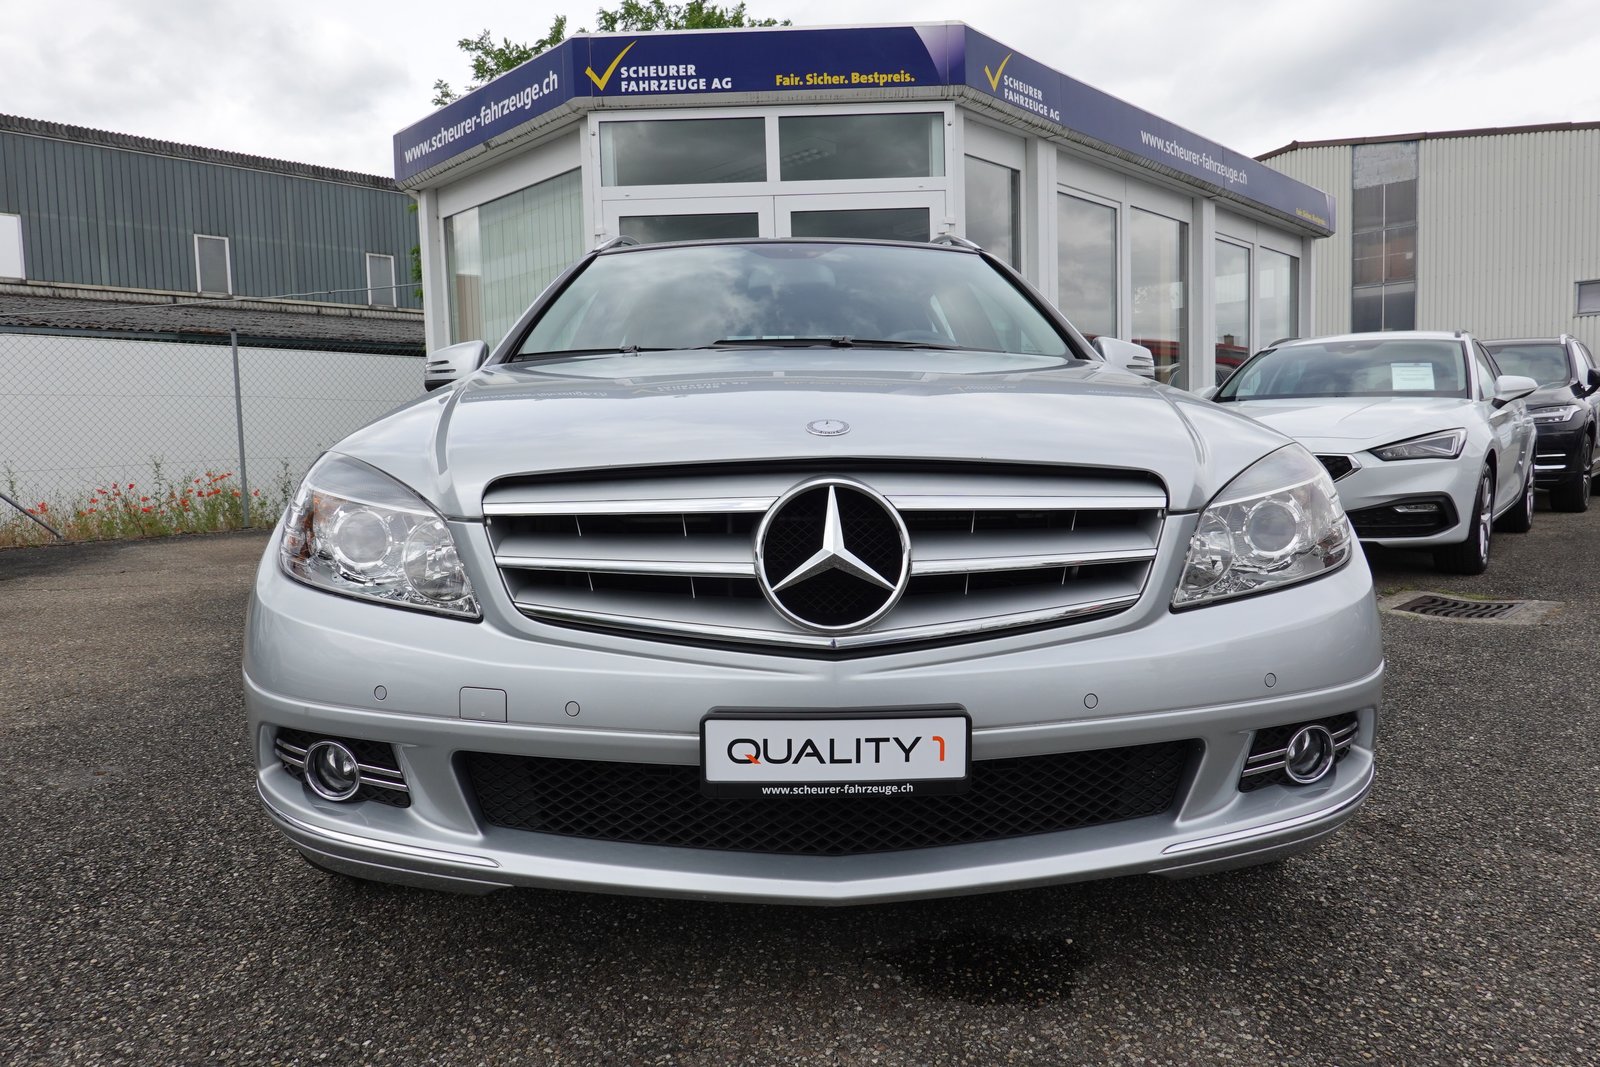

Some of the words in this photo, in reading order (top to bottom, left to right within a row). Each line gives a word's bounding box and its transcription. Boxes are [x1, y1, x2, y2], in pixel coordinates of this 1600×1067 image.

[620, 64, 697, 78] SCHEURER
[775, 73, 803, 86] Fair.
[805, 72, 849, 85] Sicher.
[851, 70, 916, 86] Bestpreis.
[621, 78, 707, 92] FAHRZEUGE
[711, 77, 732, 89] AG
[1003, 75, 1043, 101] SCHEURER
[404, 70, 558, 164] www.scheurer-fahrzeuge.ch
[1004, 88, 1048, 116] FAHRZEUGE
[1049, 108, 1060, 121] AG
[1140, 130, 1248, 184] www.scheurer-fahrzeuge.ch
[727, 736, 922, 764] QUALITY
[932, 735, 945, 762] 1
[762, 783, 914, 796] www.scheurer-fahrzeuge.ch
